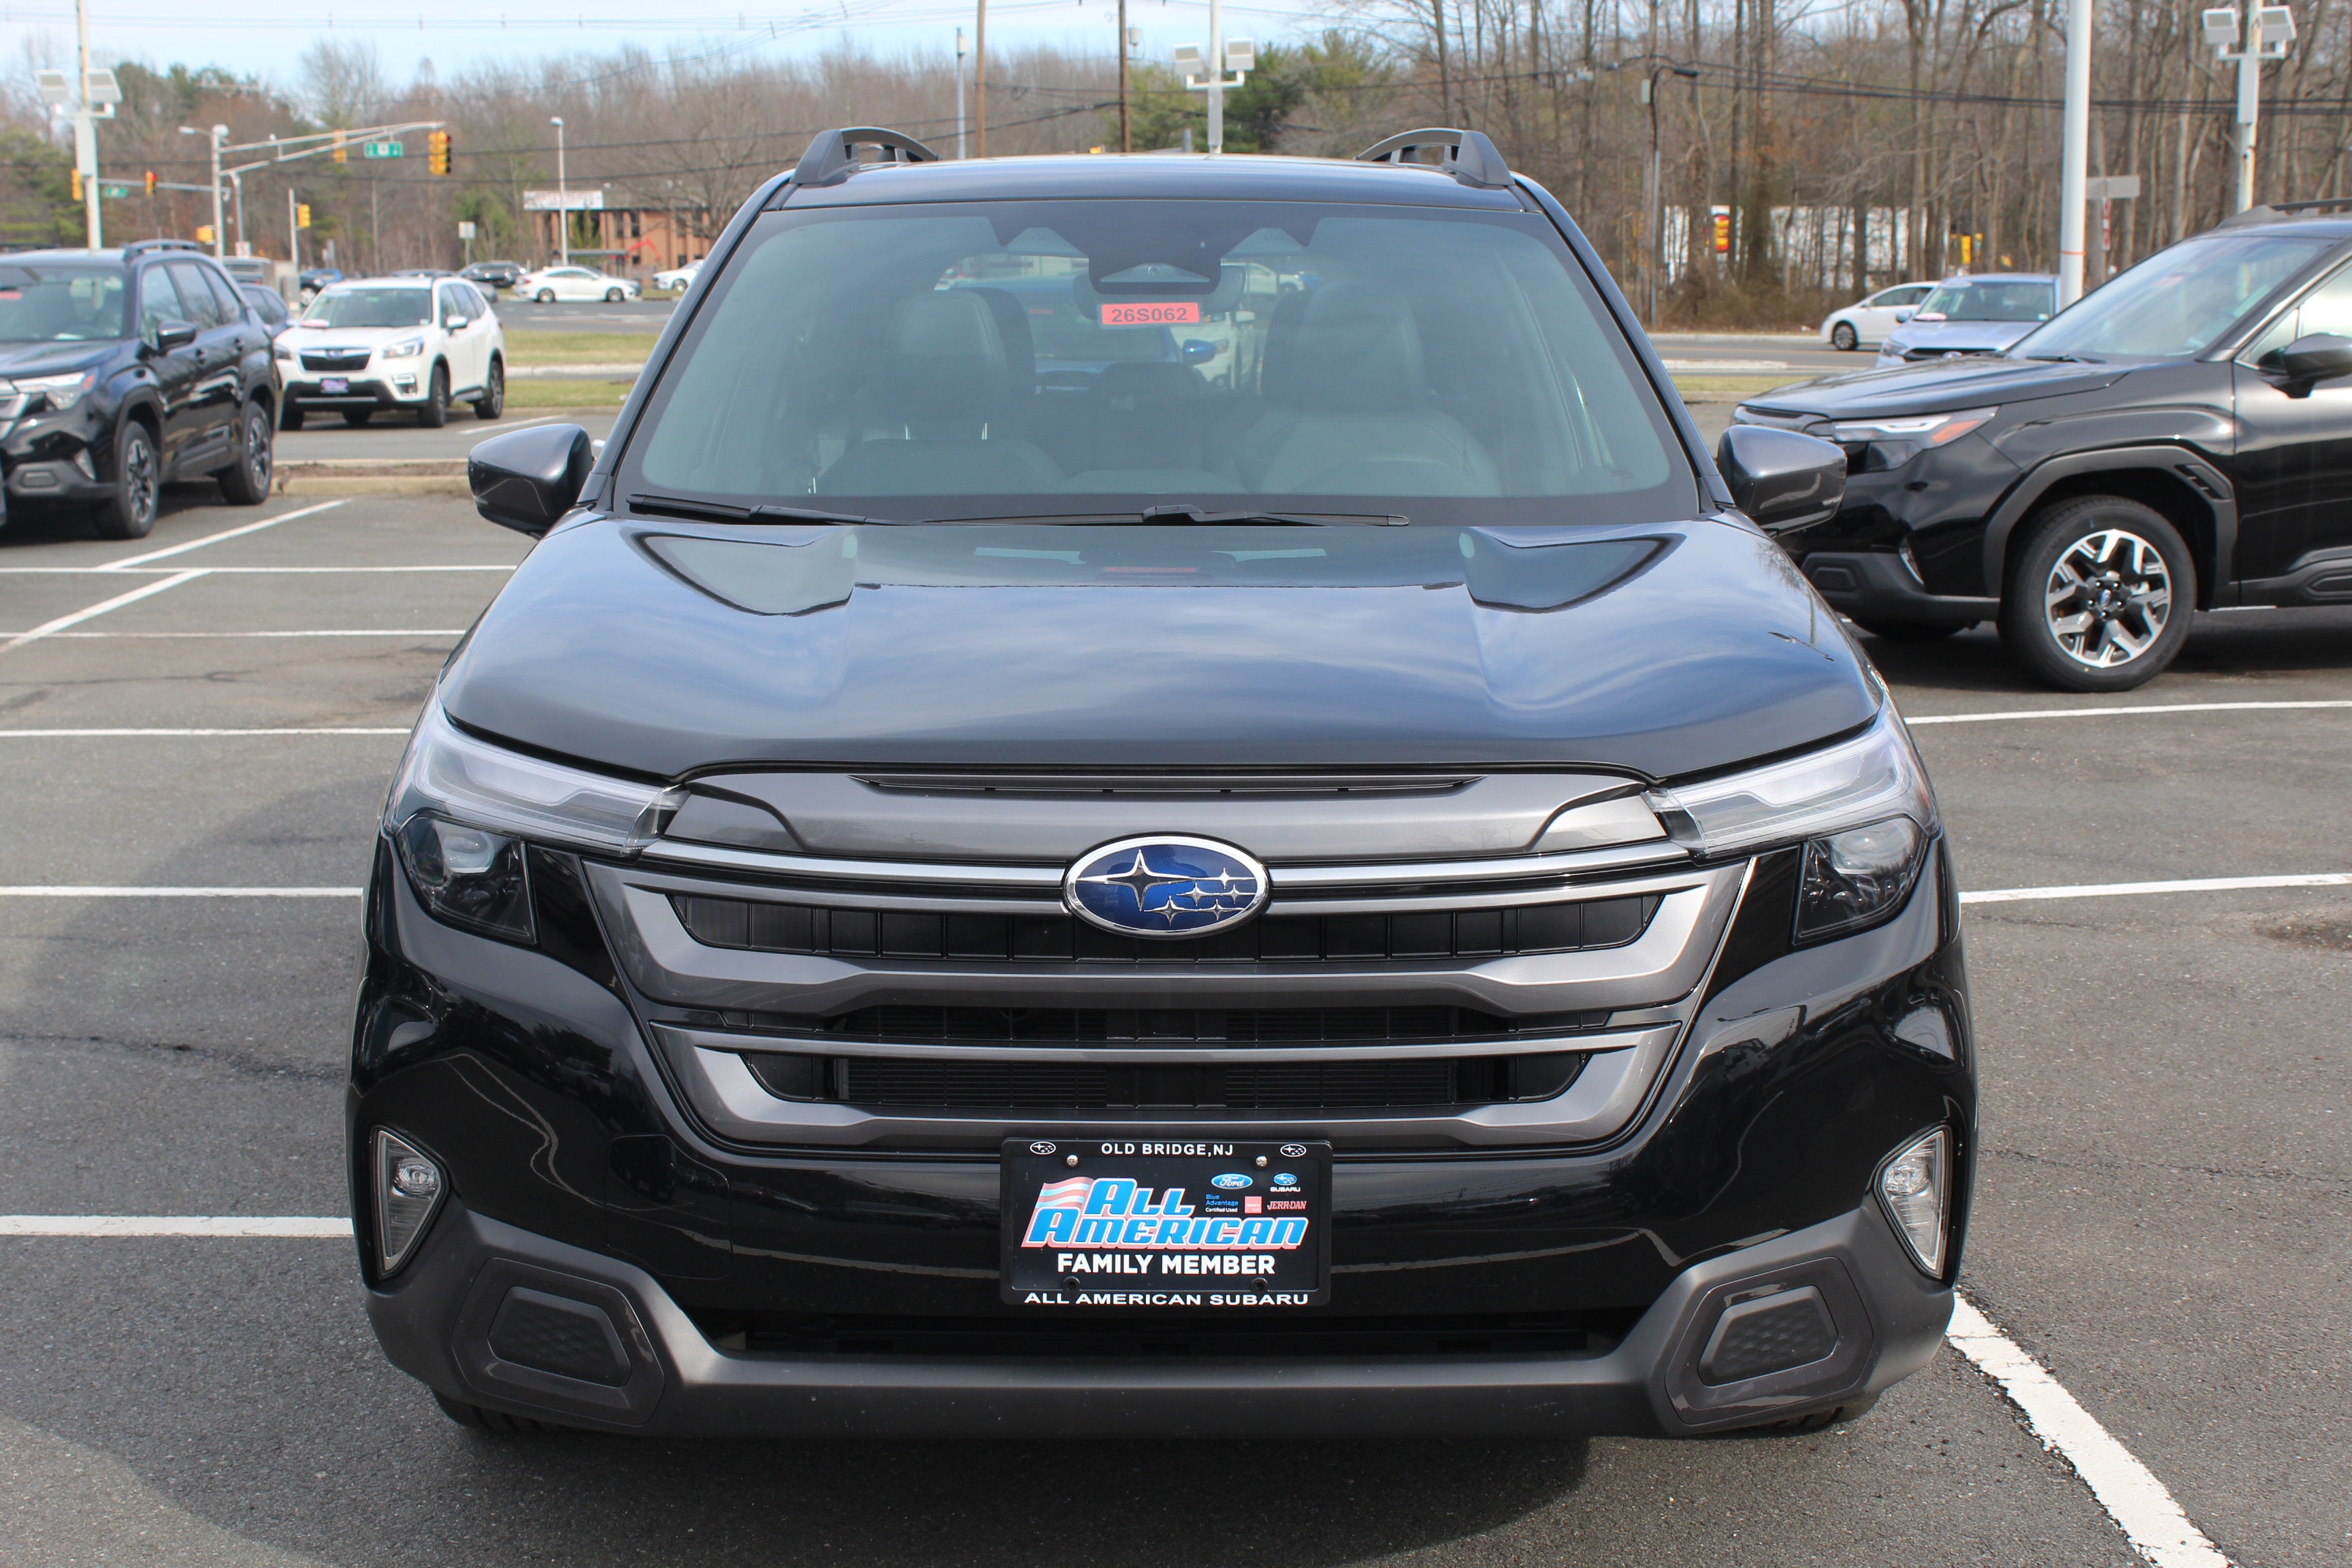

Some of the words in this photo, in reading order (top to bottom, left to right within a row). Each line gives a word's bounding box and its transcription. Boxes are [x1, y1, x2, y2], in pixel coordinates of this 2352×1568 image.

[1111, 308, 1188, 323] 26S062
[1100, 1143, 1134, 1156] OLD
[1141, 1143, 1233, 1157] BRIDGE,NJ
[1220, 1175, 1245, 1188] Ford
[1058, 1253, 1154, 1274] FAMILY
[1161, 1254, 1275, 1275] MEMBER
[1024, 1292, 1069, 1304] ALL
[1076, 1293, 1201, 1305] AMERICAN
[1209, 1294, 1308, 1305] SUBARU
